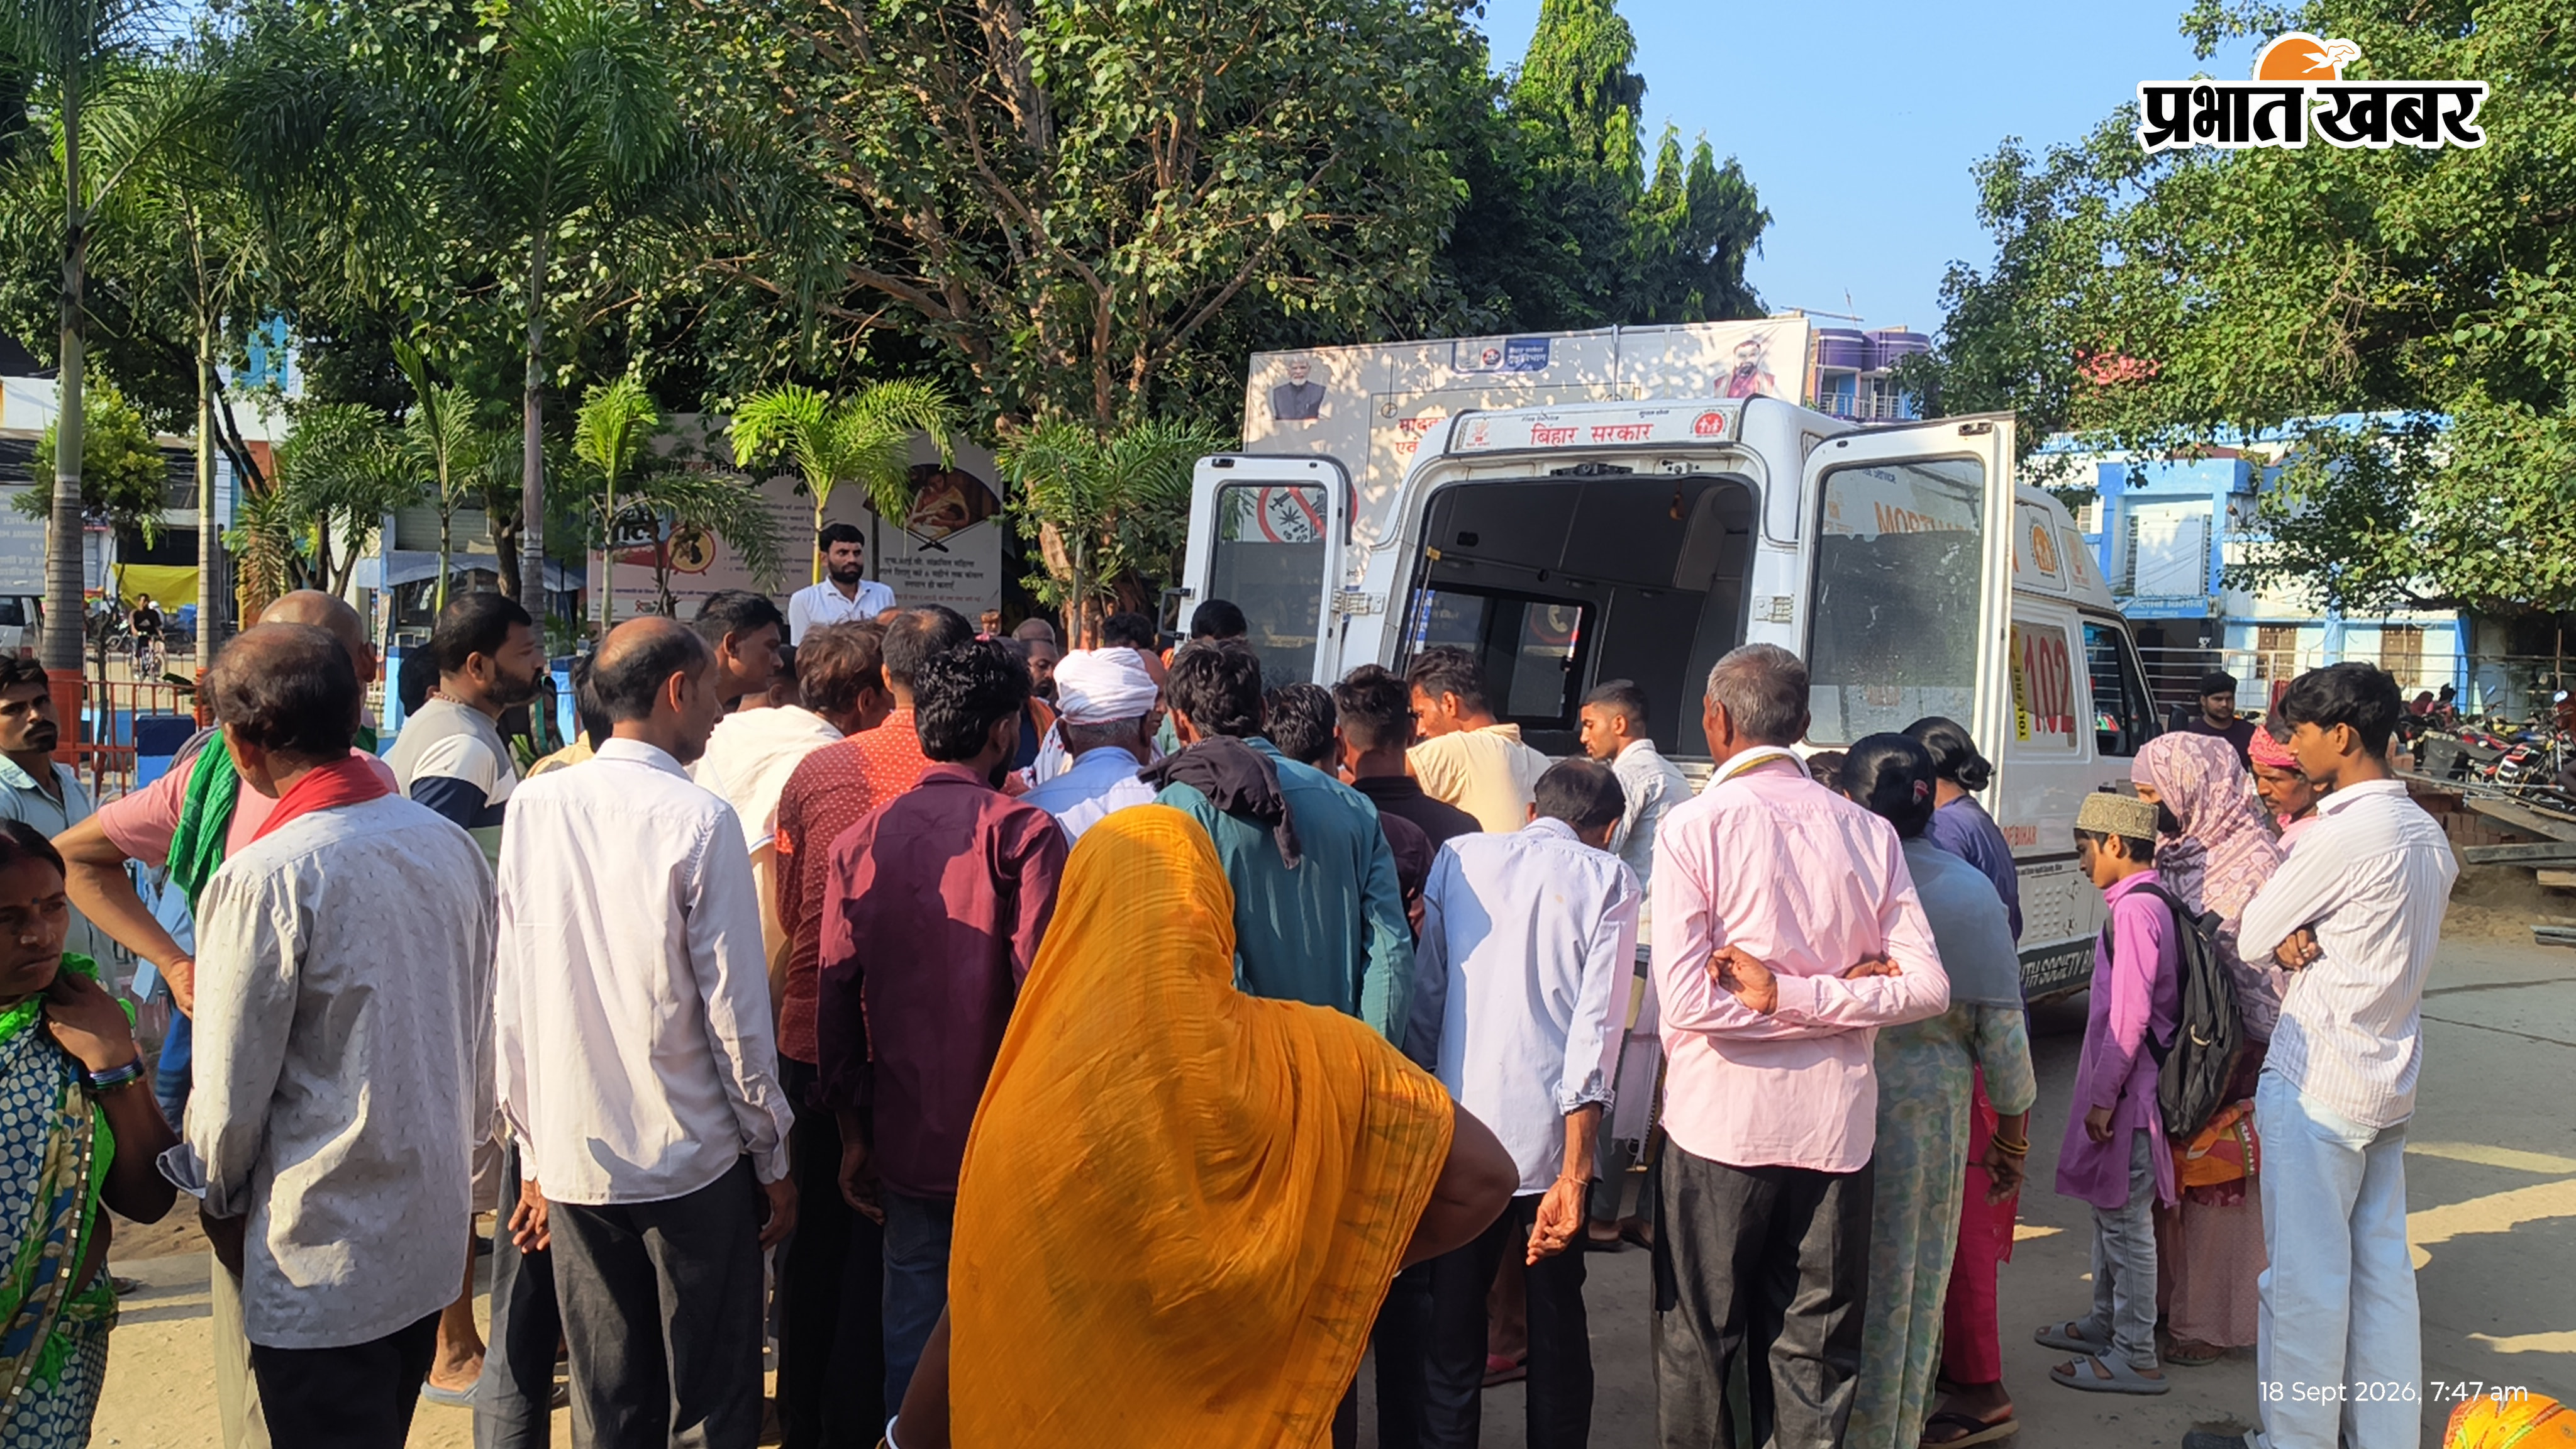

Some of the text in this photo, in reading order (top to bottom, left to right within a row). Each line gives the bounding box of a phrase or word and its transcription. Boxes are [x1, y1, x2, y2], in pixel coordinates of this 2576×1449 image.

[1531, 423, 1655, 448] बिहार सरकार
[2014, 665, 2023, 702] FREE
[2024, 634, 2074, 734] 102
